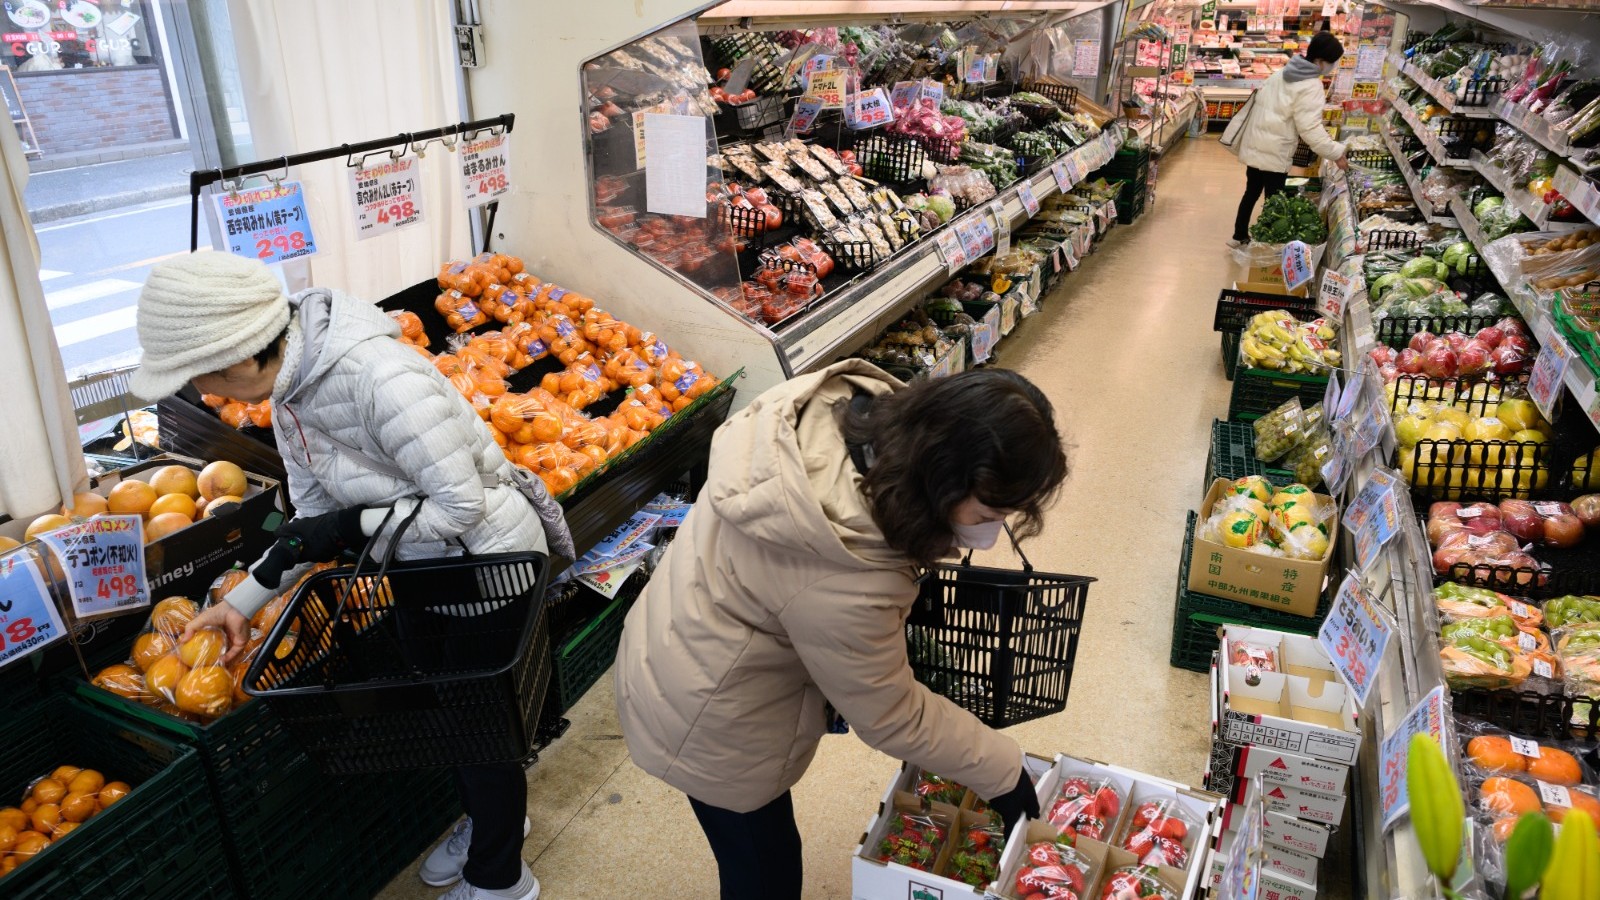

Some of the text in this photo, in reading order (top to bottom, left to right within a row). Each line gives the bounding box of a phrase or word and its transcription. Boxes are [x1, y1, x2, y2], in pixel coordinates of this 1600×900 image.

[463, 154, 506, 177] 味まるみかん
[66, 543, 138, 568] デコポン(不知火)
[1208, 552, 1223, 576] 南国
[1208, 580, 1291, 605] 中部九州青果組合
[1281, 568, 1299, 593] 特産
[1339, 598, 1377, 658] とちあいか
